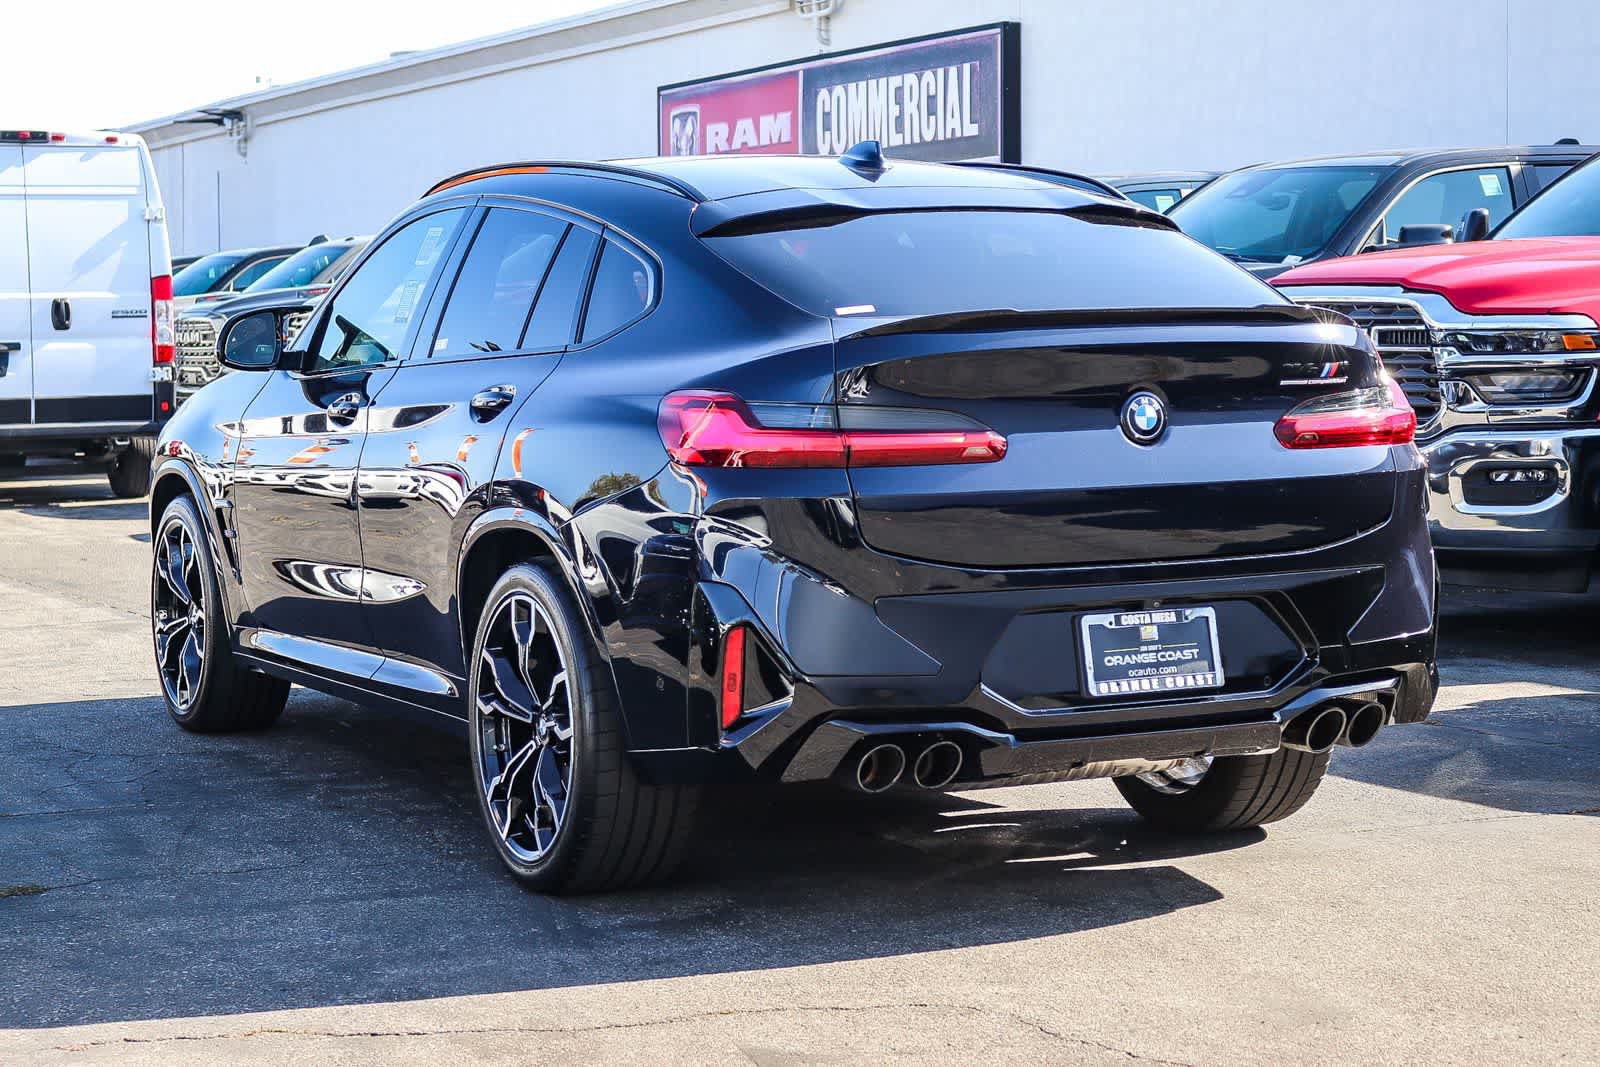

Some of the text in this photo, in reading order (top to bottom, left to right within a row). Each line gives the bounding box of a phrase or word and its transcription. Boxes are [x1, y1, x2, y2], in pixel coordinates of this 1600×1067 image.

[815, 63, 979, 155] COMMERCIAL
[707, 113, 790, 153] RAM
[1121, 612, 1176, 625] COSTA MESA
[1104, 649, 1199, 667] ORANGE COAST
[1128, 665, 1178, 677] ocauto.com
[1100, 675, 1213, 693] ORANGE COAST
